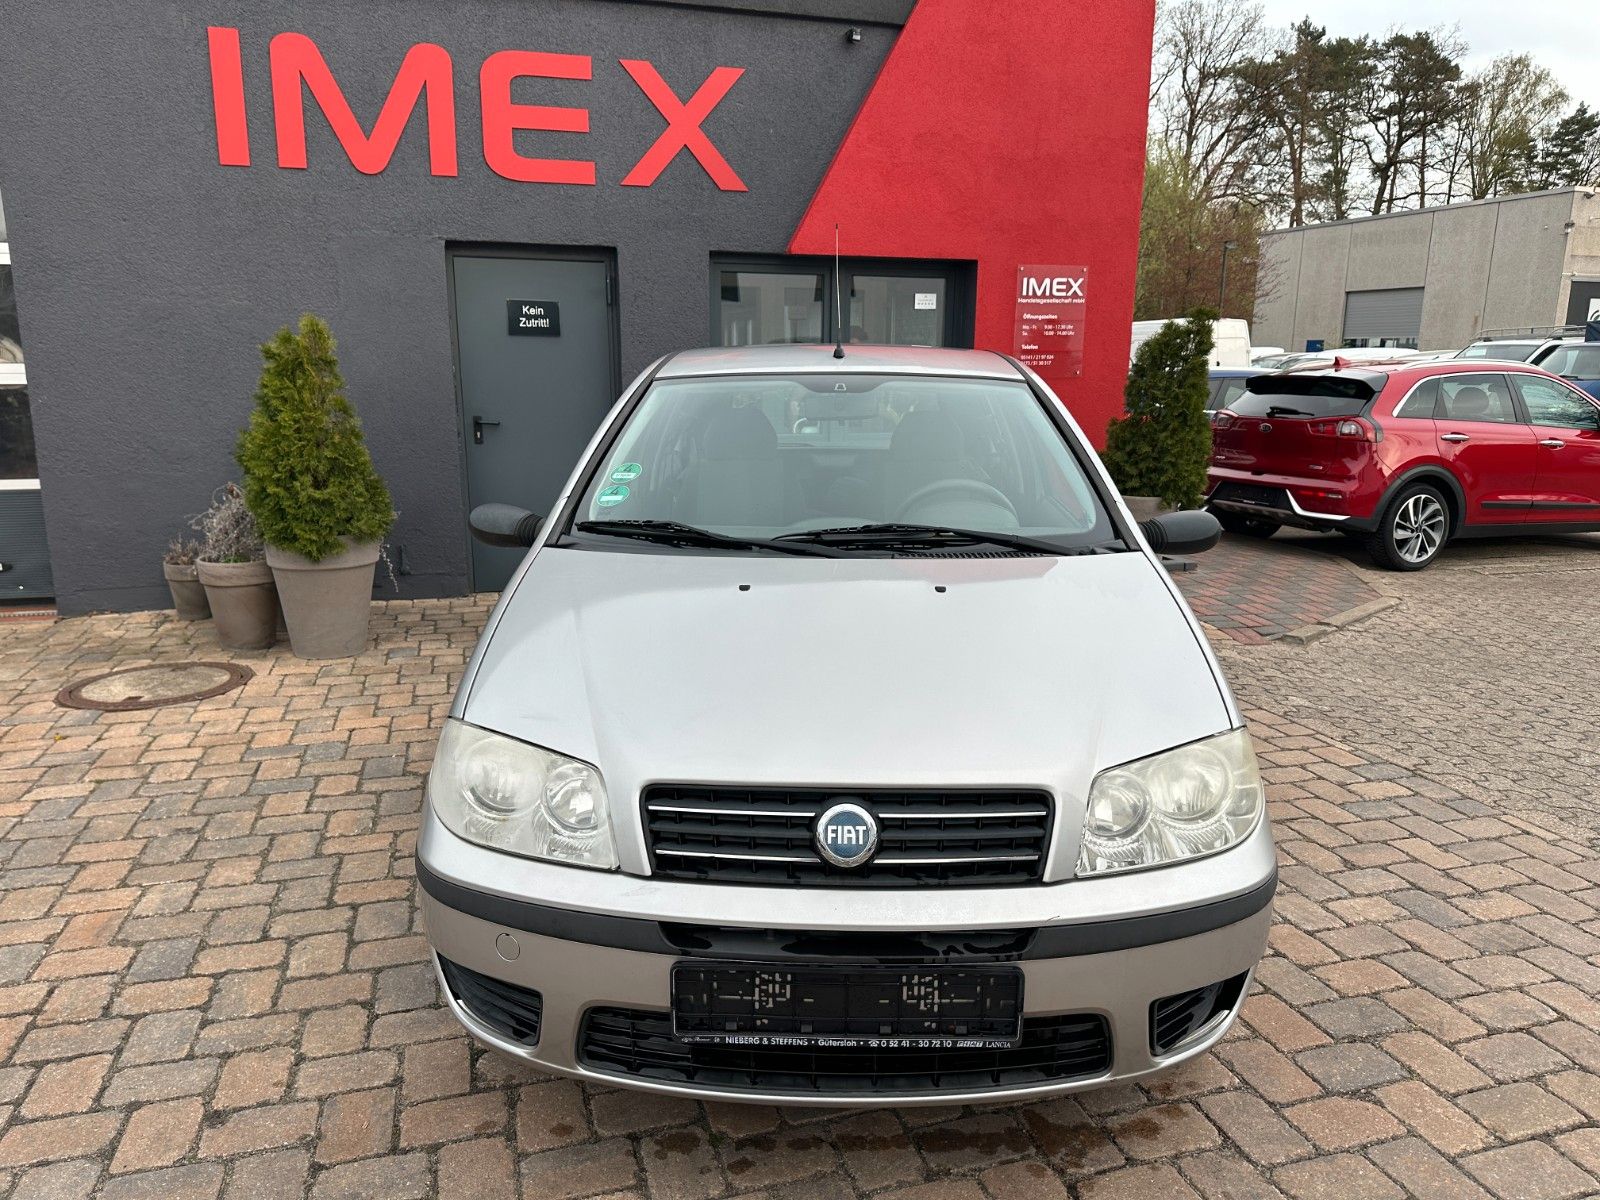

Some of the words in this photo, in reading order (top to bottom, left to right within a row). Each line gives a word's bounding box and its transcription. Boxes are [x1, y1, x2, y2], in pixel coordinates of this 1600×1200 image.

[208, 26, 748, 191] IMEX
[1022, 277, 1084, 296] IMEX
[522, 305, 544, 315] Kein
[519, 317, 549, 327] Zutritt!
[827, 825, 867, 845] FIAT
[771, 1037, 808, 1046] STEFFENS
[818, 1039, 857, 1047] Gütersloh
